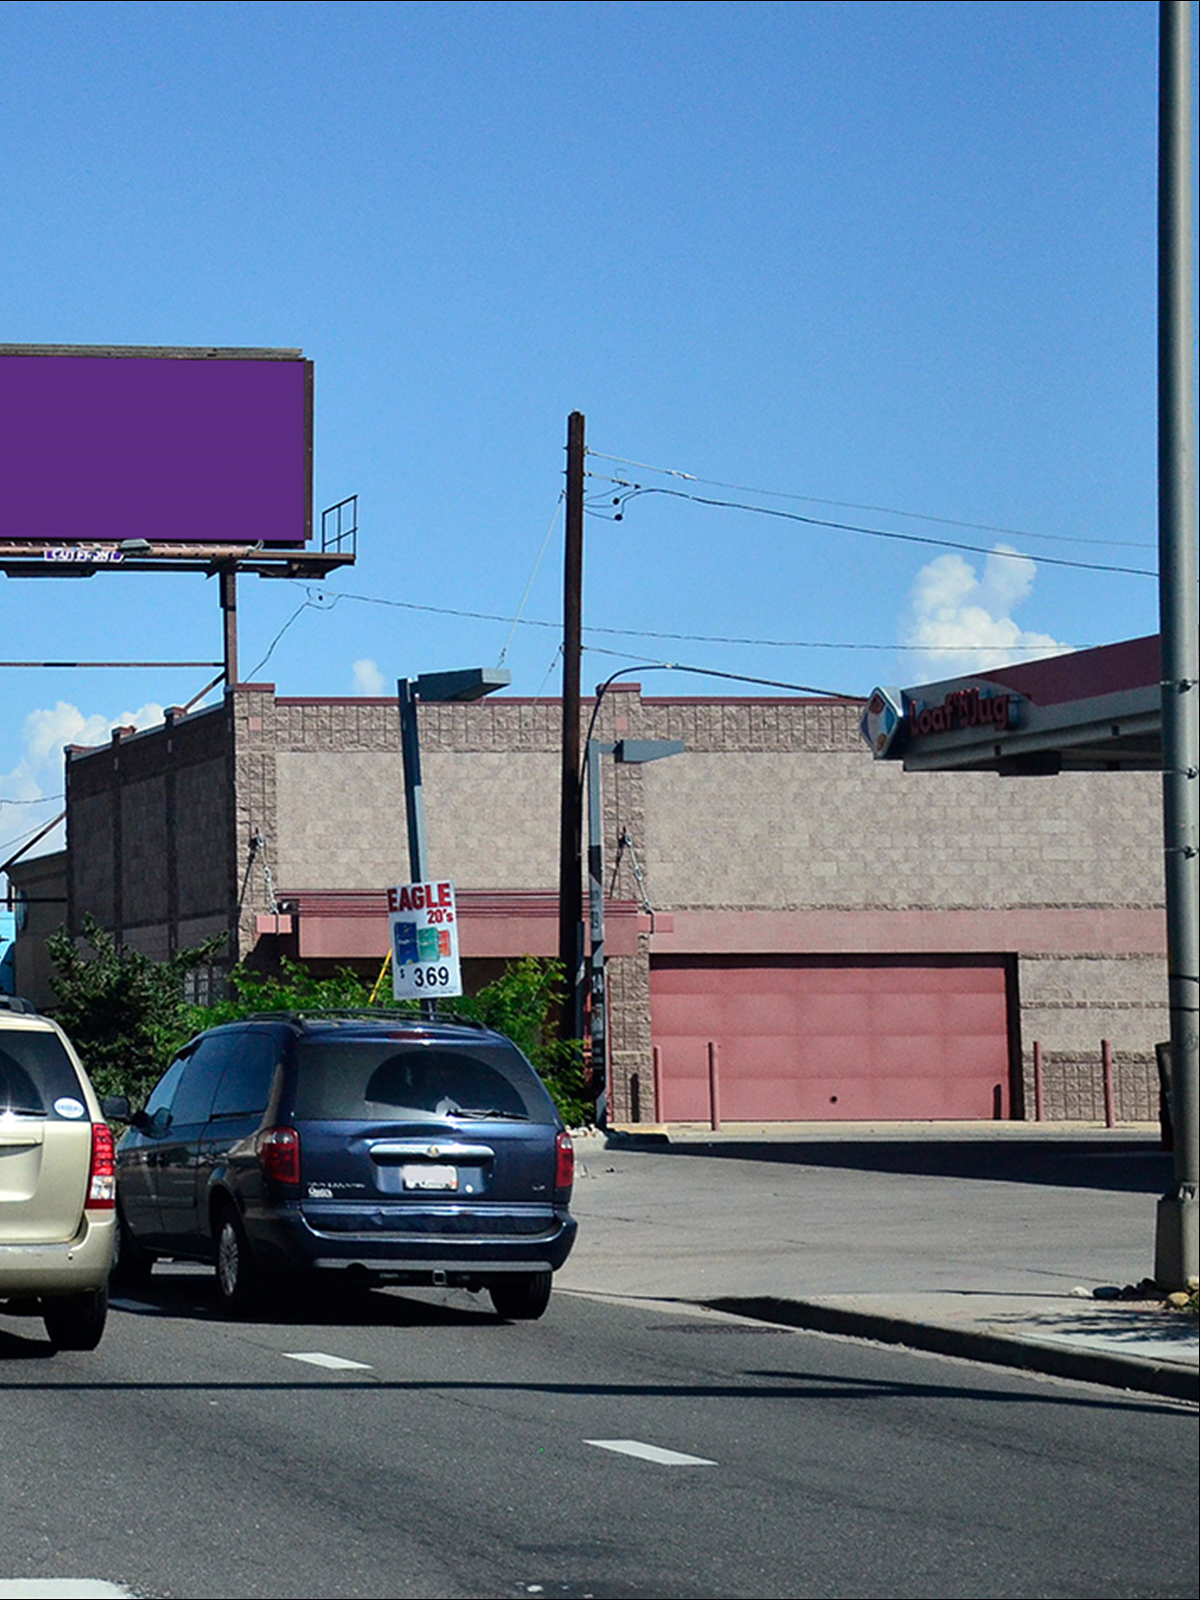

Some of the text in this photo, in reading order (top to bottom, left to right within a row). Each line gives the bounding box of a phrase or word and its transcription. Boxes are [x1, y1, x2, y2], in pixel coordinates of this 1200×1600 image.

[909, 692, 955, 736] Loaf
[970, 687, 1010, 731] Jug
[387, 882, 452, 912] EAGLE
[426, 908, 454, 925] 20's
[414, 966, 450, 988] 369
